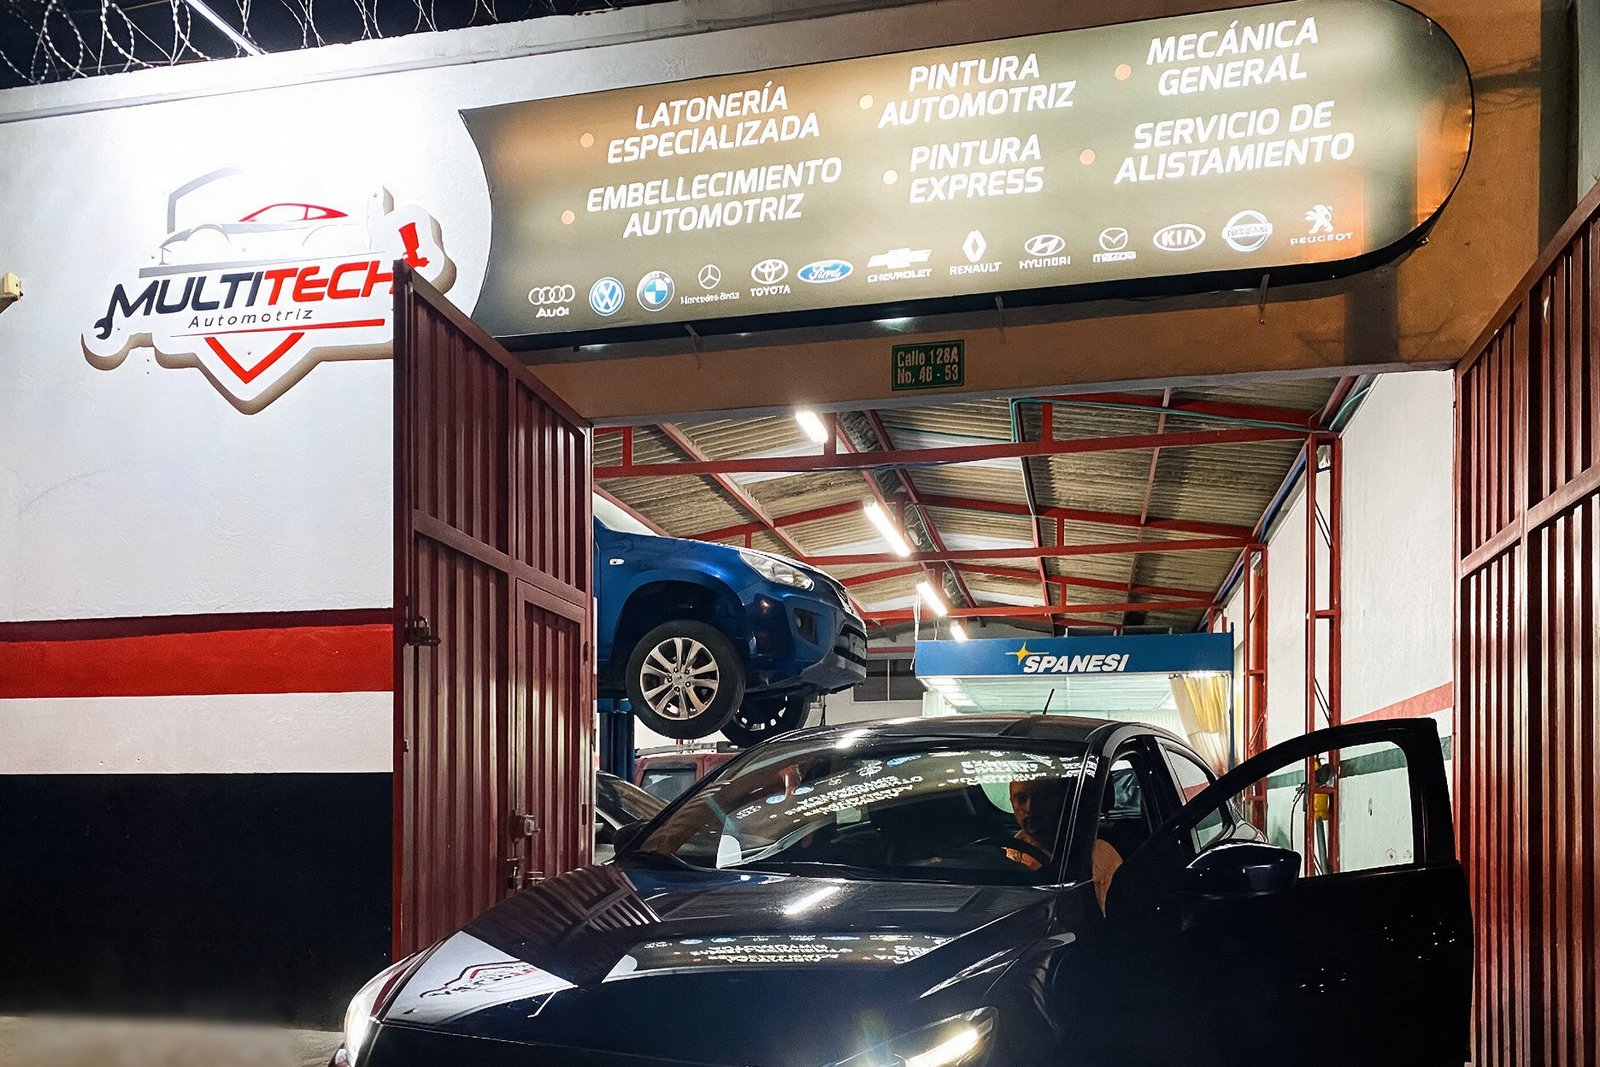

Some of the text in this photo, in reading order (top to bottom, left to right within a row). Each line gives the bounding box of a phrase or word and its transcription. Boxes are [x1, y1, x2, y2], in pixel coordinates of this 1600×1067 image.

[1146, 16, 1319, 65] MECÁNICA
[908, 53, 1040, 92] PINTURA
[1157, 53, 1308, 96] GENERAL
[635, 80, 788, 130] LATONERÍA
[877, 80, 1077, 128] AUTOMOTRIZ
[1133, 101, 1335, 150] SERVICIO DE
[607, 112, 820, 164] ESPECIALIZADA
[909, 133, 1041, 172] PINTURA
[1113, 132, 1355, 184] ALISTAMIENTO
[586, 156, 842, 212] EMBELLECIMIENTO
[909, 166, 1044, 204] EXPRESS
[622, 193, 805, 239] AUTOMOTRIZ
[1161, 228, 1197, 247] KIA
[750, 284, 791, 297] TOYOTA
[949, 262, 1002, 276] RENAULT
[94, 260, 394, 339] MULTITECH
[187, 308, 313, 329] Automotriz
[1023, 653, 1130, 673] SPANESI
